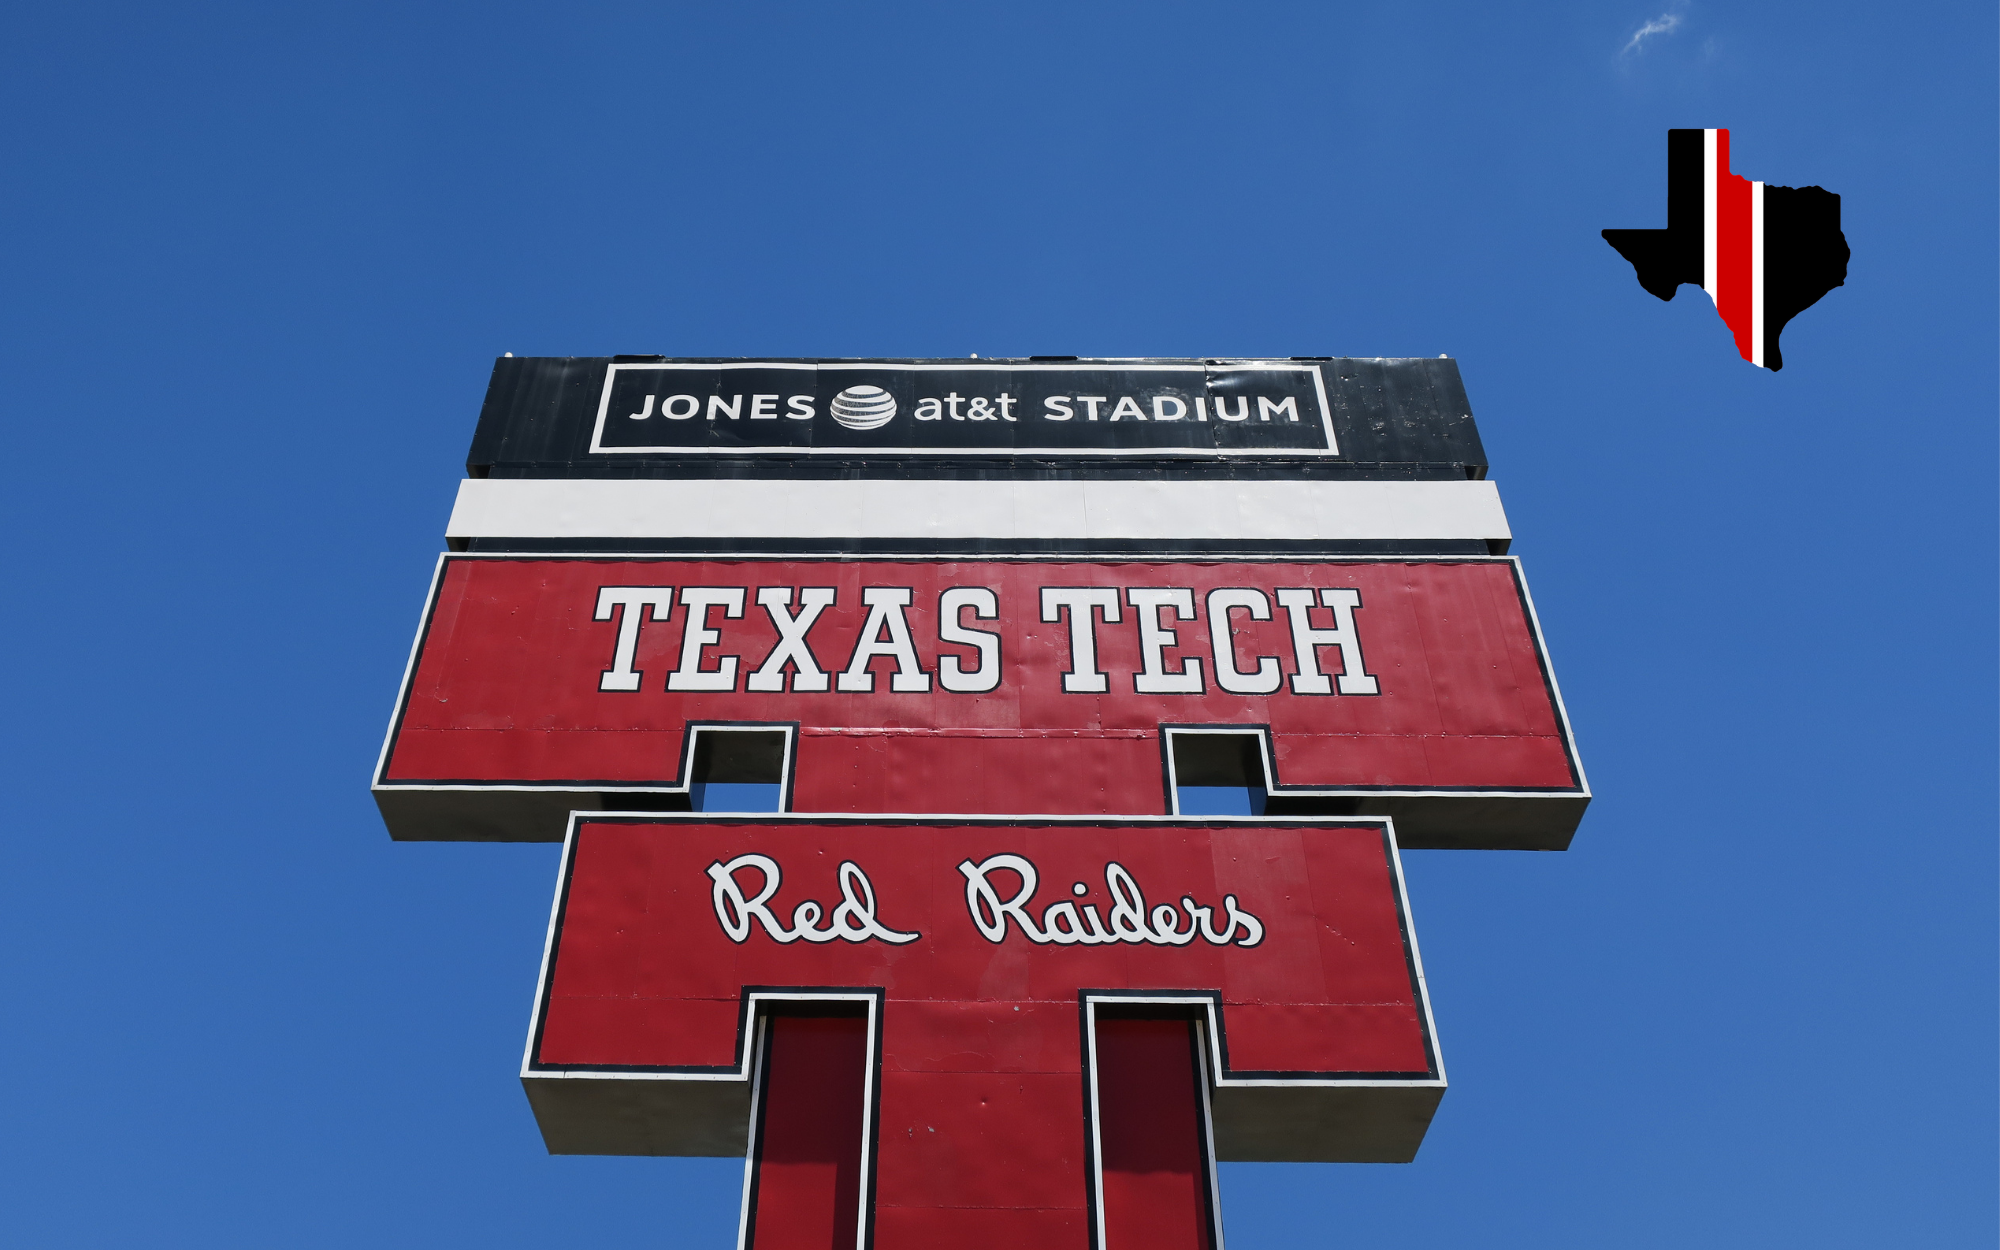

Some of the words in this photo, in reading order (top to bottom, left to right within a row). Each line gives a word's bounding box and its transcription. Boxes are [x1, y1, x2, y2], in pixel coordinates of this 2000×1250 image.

[628, 394, 816, 420] JONES
[913, 391, 1018, 422] at&t
[1043, 395, 1300, 422] STADIUM
[594, 587, 1001, 693] TEXAS
[1041, 588, 1379, 694] TECH
[706, 854, 919, 943] Red
[957, 854, 1263, 946] Raiders
